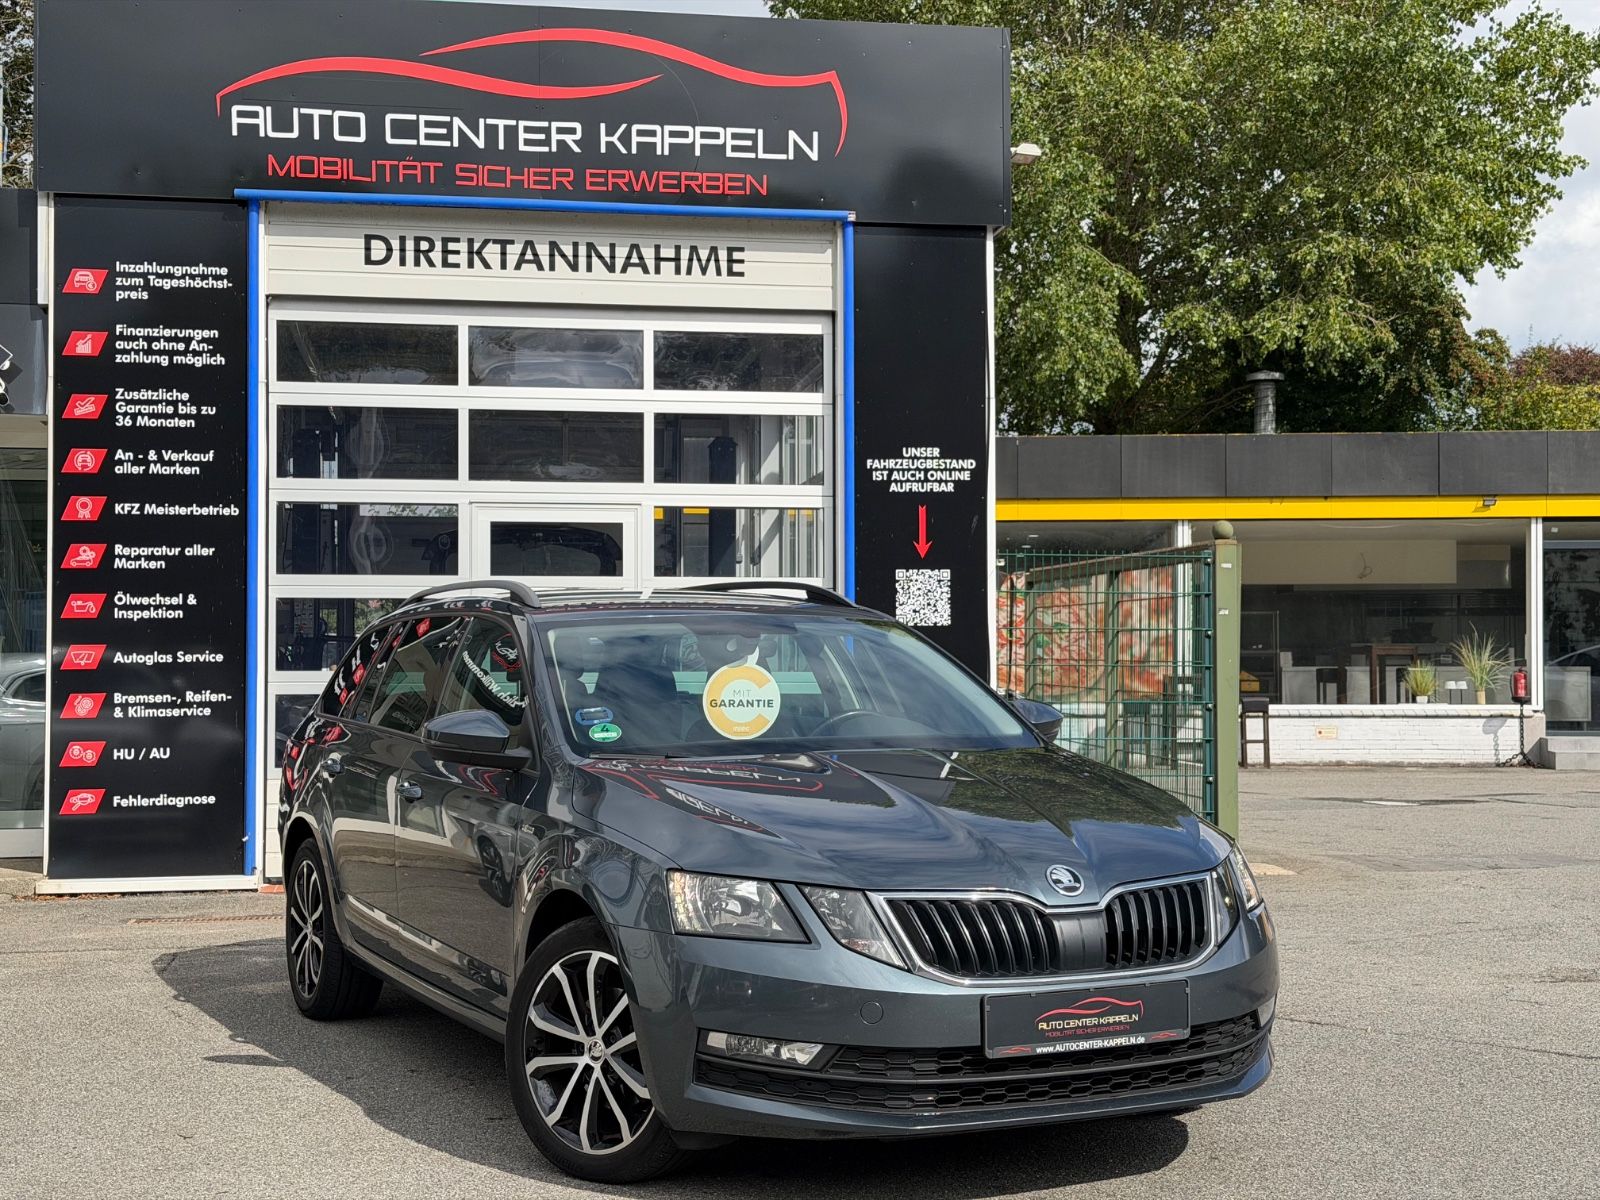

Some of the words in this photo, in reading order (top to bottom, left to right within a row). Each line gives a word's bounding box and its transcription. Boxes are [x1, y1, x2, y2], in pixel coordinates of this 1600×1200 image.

[231, 104, 366, 143] AUTO
[385, 112, 582, 153] CENTER
[600, 122, 819, 161] KAPPELN
[267, 154, 443, 184] MOBILITÄT
[456, 163, 574, 190] SICHER
[585, 168, 768, 196] ERWERBEN
[364, 234, 745, 278] DIREKTANNAHME
[115, 261, 228, 276] Inzahlungnahme
[115, 276, 144, 286] zum
[148, 275, 233, 289] Tageshöchst-
[115, 288, 149, 301] preis
[115, 324, 219, 340] Finanzierungen
[115, 338, 148, 350] auch
[152, 339, 185, 351] ohne
[189, 340, 213, 352] An-
[115, 352, 169, 366] zahlung
[173, 352, 225, 367] möglich
[115, 388, 190, 401] Zusätzliche
[115, 402, 174, 414] Garantie
[178, 403, 197, 414] bis
[201, 406, 216, 415] zu
[115, 416, 132, 427] 36
[136, 416, 195, 428] Monaten
[114, 449, 133, 460] An
[148, 450, 158, 461] &
[162, 450, 214, 462] Verkauf
[902, 447, 940, 458] UNSER
[114, 462, 145, 474] aller
[149, 463, 200, 475] Marken
[867, 459, 976, 469] FAHRZEUGBESTAND
[872, 471, 888, 481] IST
[891, 471, 924, 481] AUCH
[927, 471, 971, 481] ONLINE
[889, 482, 954, 492] AUFRUFBAR
[114, 503, 141, 514] KFZ
[144, 503, 240, 516] Meisterbetrieb
[114, 544, 181, 558] Reparatur
[184, 544, 215, 556] aller
[114, 558, 166, 569] Marken
[114, 591, 184, 605] Ölwechsel
[187, 594, 197, 605] &
[114, 607, 184, 621] Inspektion
[113, 651, 173, 665] Autoglas
[177, 650, 224, 663] Service
[113, 692, 182, 705] Bremsen-,
[185, 690, 232, 702] Reifen-
[733, 689, 751, 697] MIT
[710, 699, 774, 708] GARANTIE
[113, 707, 123, 718] &
[128, 705, 212, 717] Klimaservice
[601, 725, 610, 733] 4
[113, 749, 134, 760] HU
[138, 748, 146, 760] /
[150, 747, 170, 759] AU
[112, 794, 216, 808] Fehlerdiagnose
[1038, 1021, 1063, 1030] AUTO
[1064, 1018, 1099, 1028] CENTER
[1099, 1014, 1138, 1024] KAPPELN
[1036, 1036, 1146, 1054] www.AUTOCENTER-KAPPELN.de
